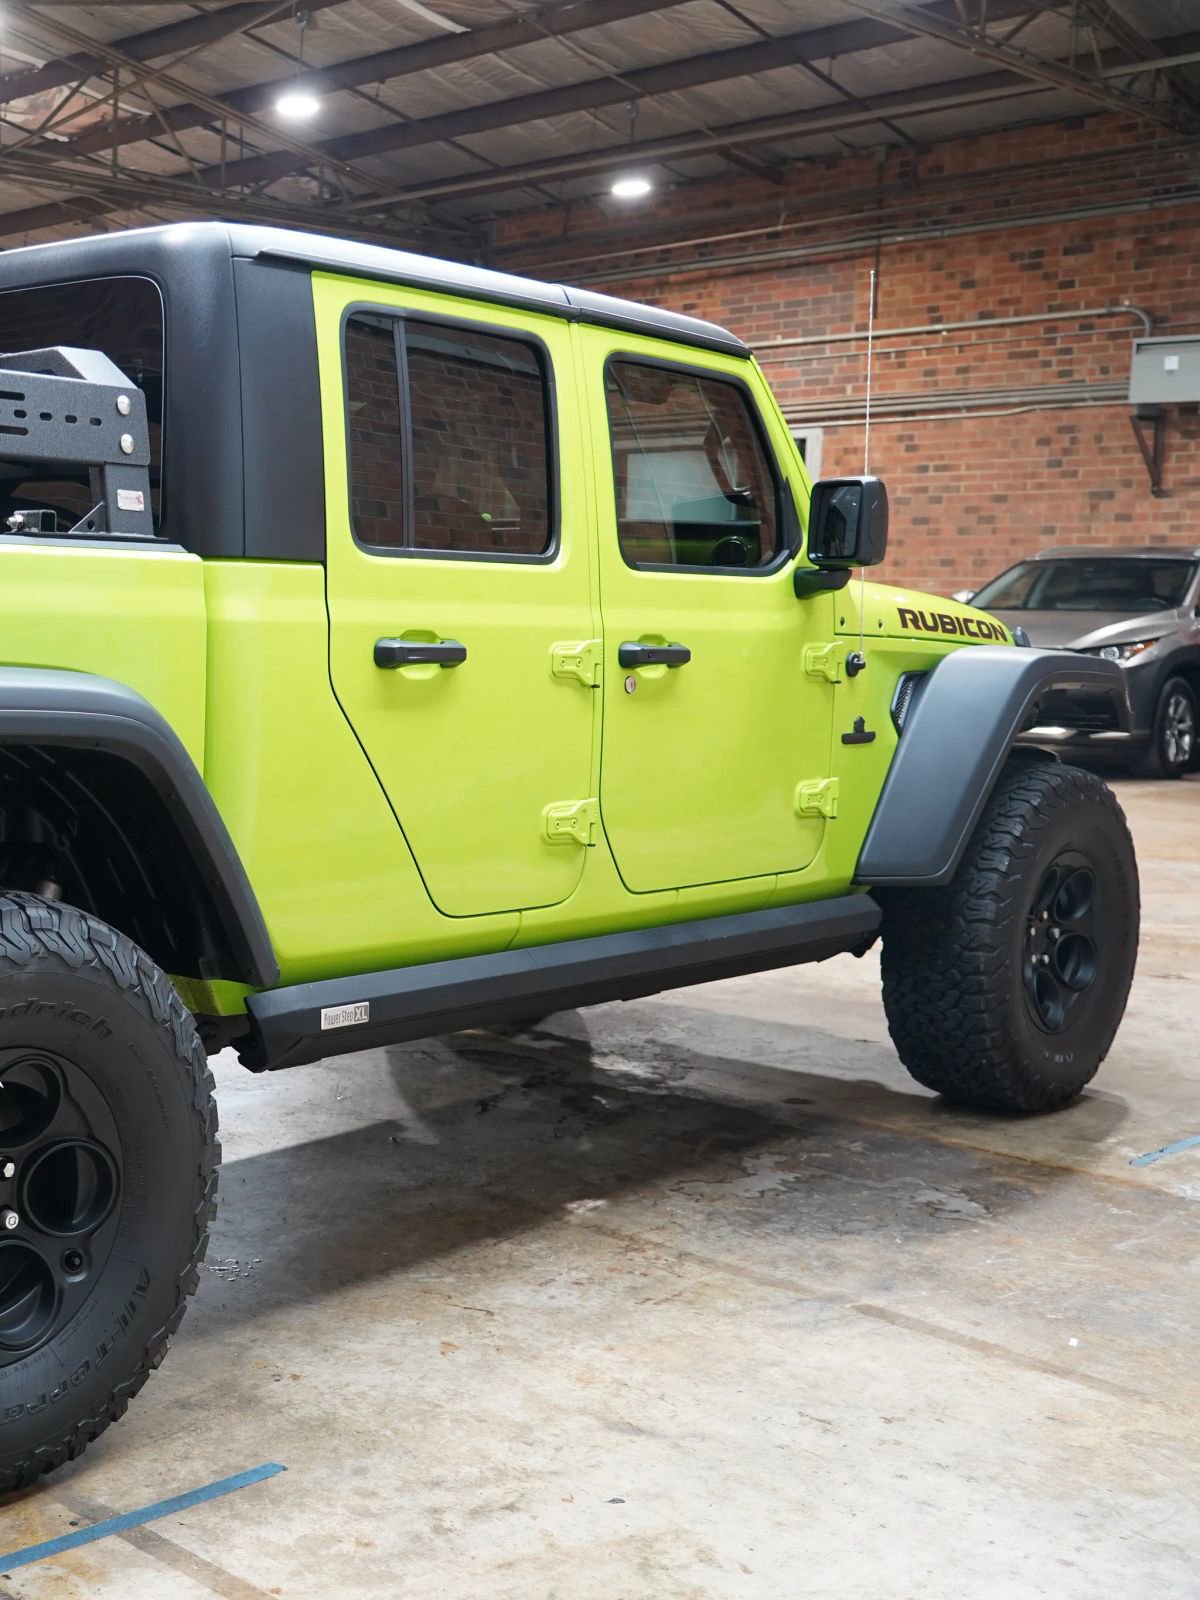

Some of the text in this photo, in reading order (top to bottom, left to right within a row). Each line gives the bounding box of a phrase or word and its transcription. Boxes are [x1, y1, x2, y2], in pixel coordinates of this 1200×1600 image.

[898, 608, 1008, 641] RUBICON
[323, 1007, 368, 1026] Power Step XL
